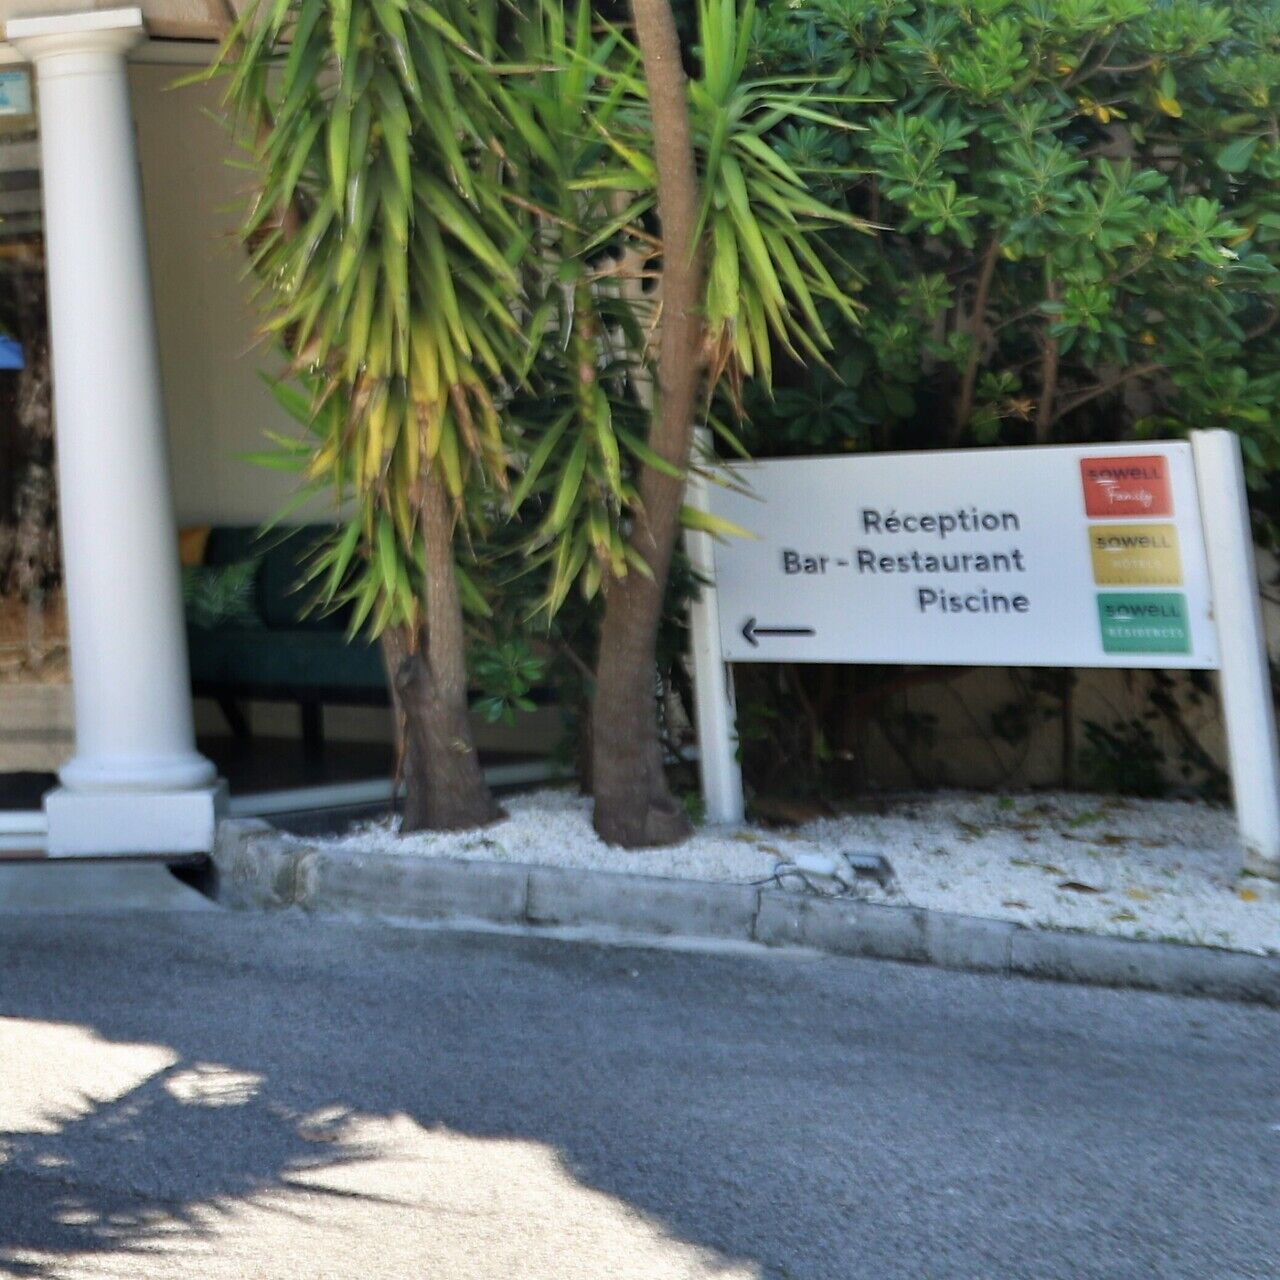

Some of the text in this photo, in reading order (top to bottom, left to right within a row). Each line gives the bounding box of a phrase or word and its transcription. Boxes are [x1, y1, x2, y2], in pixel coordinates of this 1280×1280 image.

[862, 507, 1022, 540] Réception
[783, 550, 829, 575] Bar
[857, 549, 1027, 575] Restaurant
[917, 586, 1031, 614] Piscine
